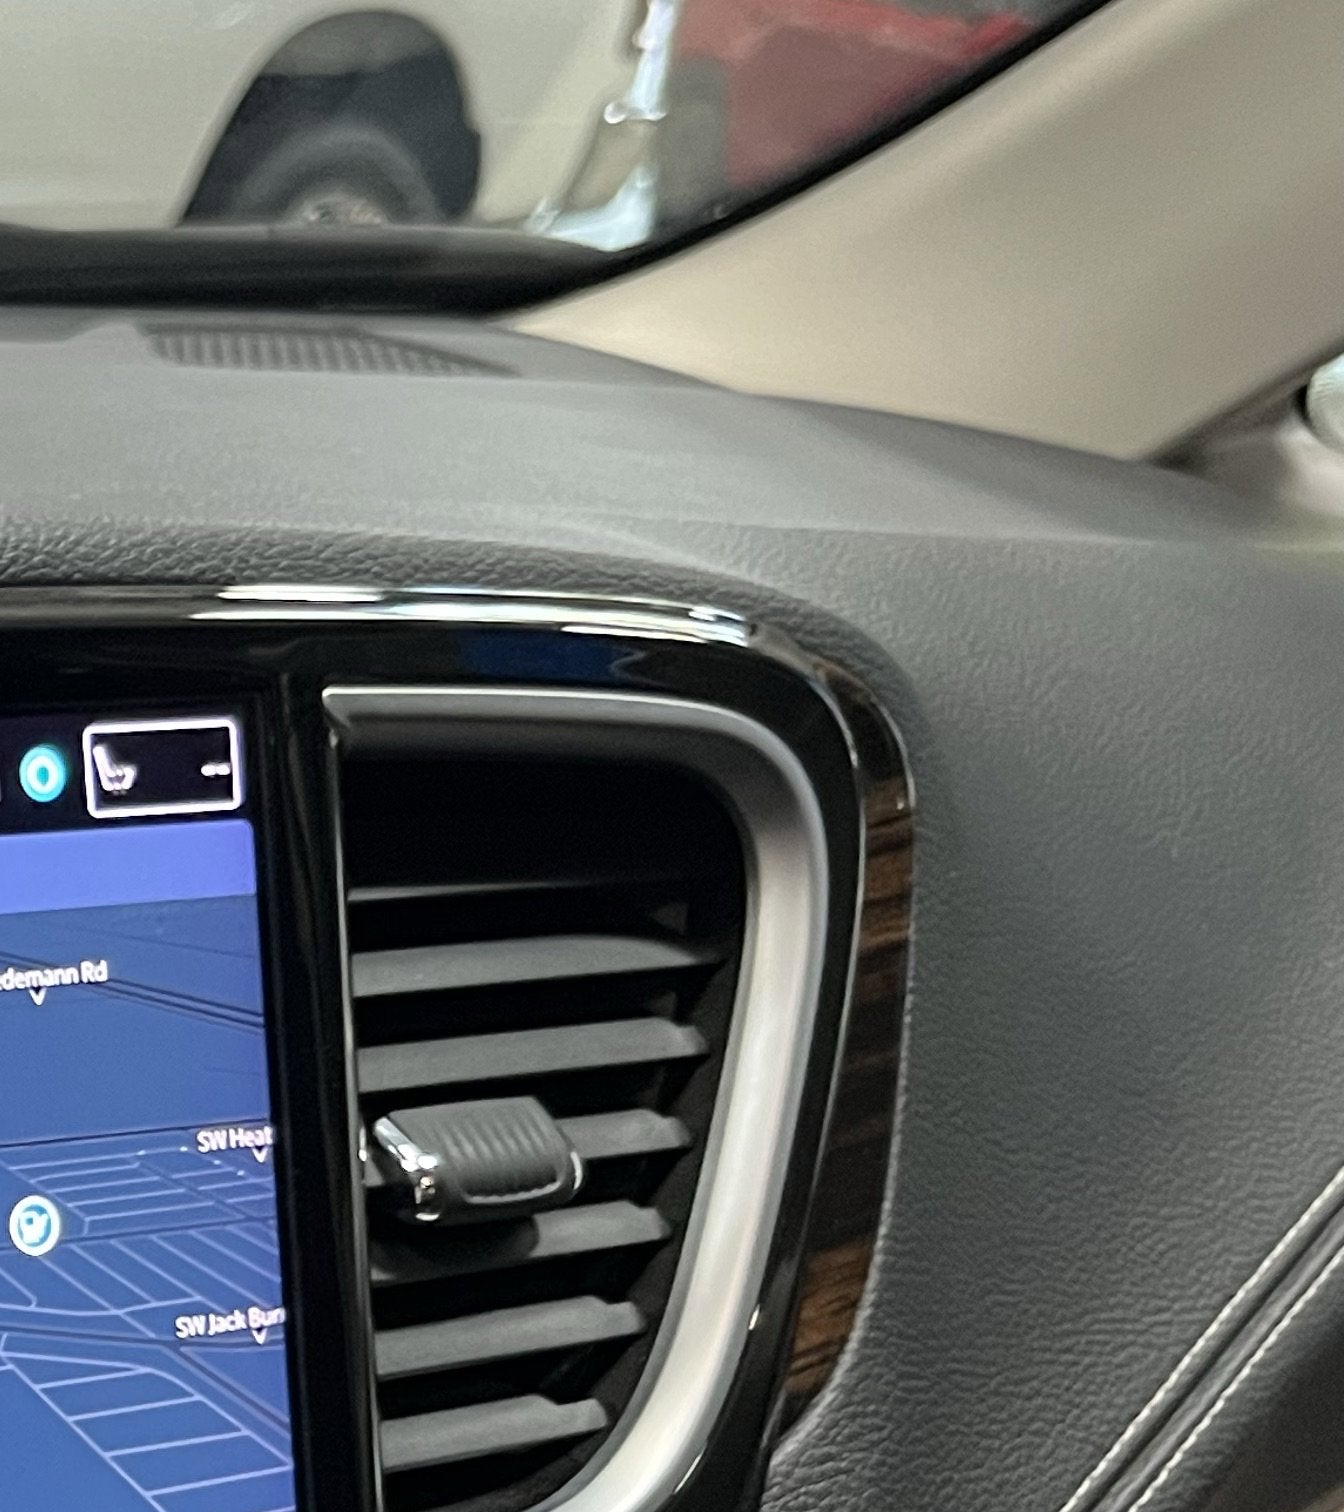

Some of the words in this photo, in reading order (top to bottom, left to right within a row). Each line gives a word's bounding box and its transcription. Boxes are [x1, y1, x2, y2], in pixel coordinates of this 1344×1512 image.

[79, 960, 108, 984] Rd
[197, 1130, 227, 1153] SW
[175, 1313, 207, 1339] SW
[208, 1309, 248, 1336] Jack
